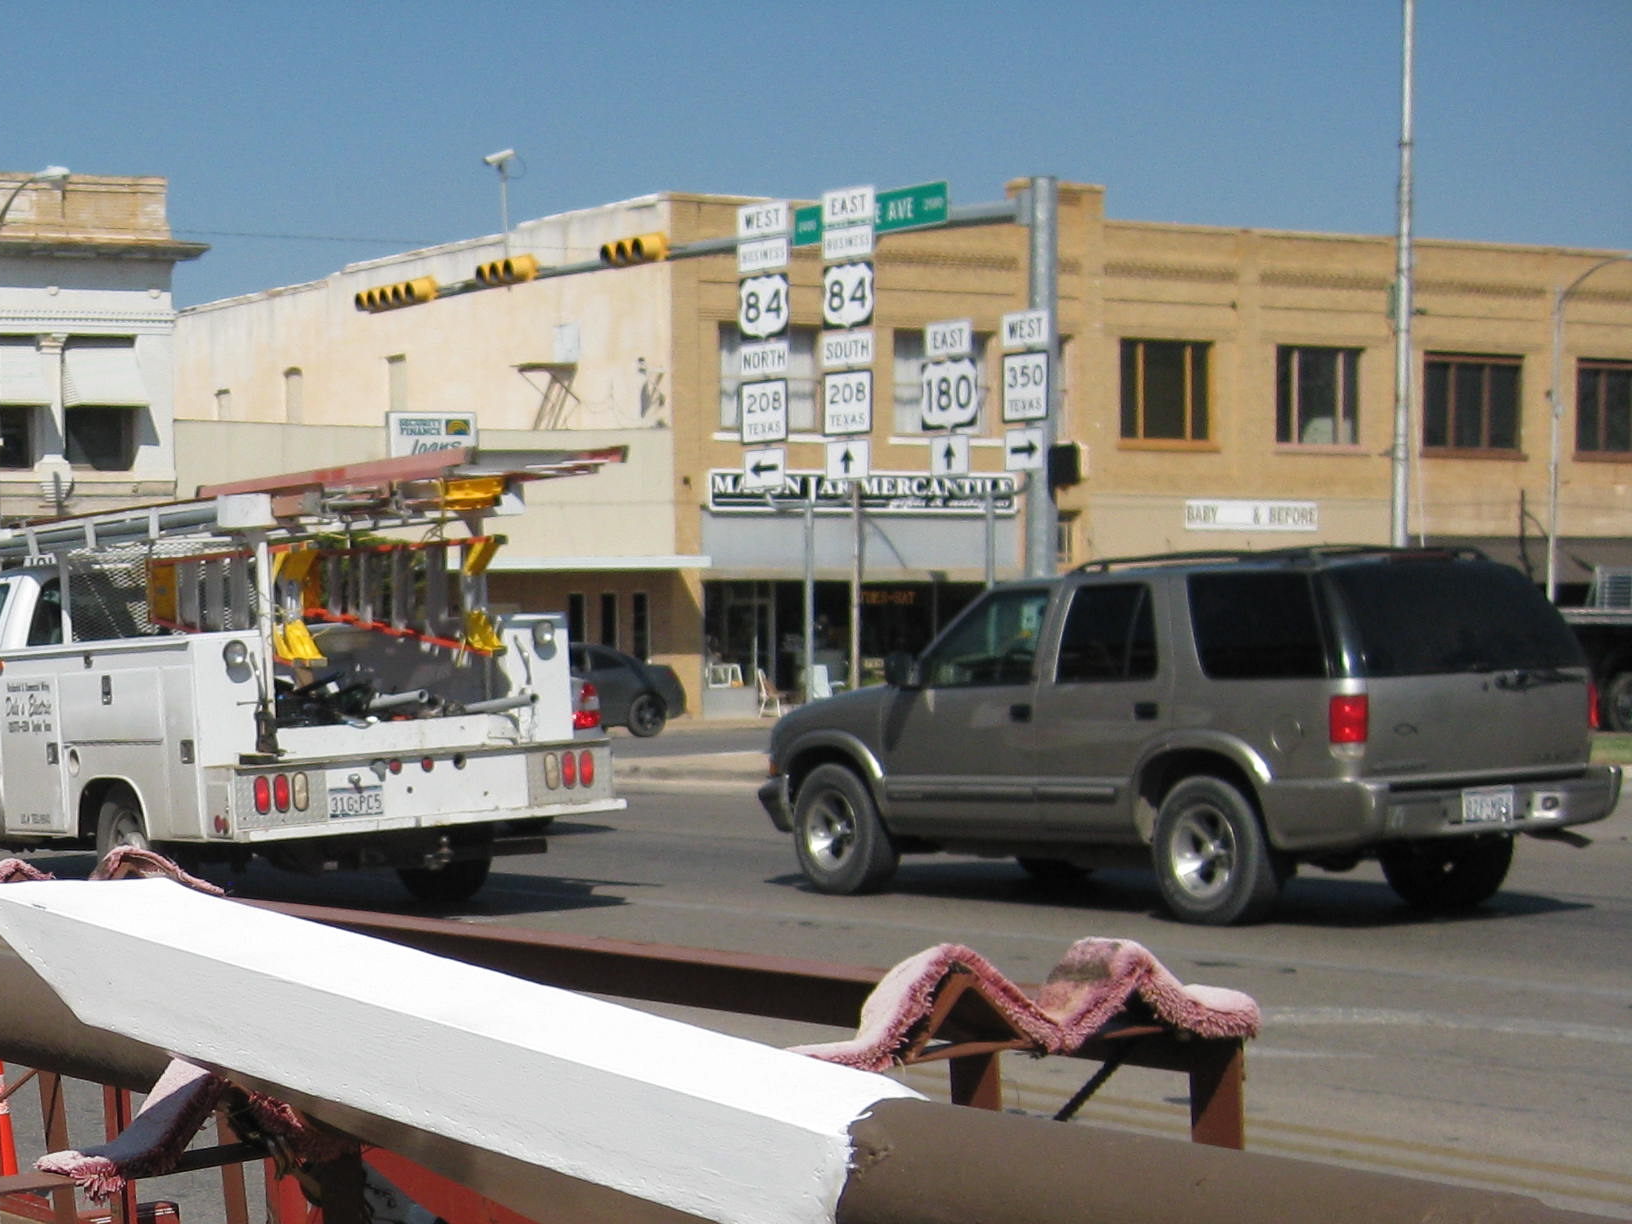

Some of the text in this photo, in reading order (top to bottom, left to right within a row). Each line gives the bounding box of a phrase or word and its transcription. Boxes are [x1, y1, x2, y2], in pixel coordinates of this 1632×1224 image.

[831, 194, 866, 216] EAST
[888, 197, 914, 221] AVE
[744, 208, 780, 231] WEST
[827, 235, 870, 251] BUSINESS
[742, 247, 786, 264] BUSINESS
[829, 276, 867, 312] 84
[745, 288, 782, 323] 84
[933, 328, 965, 350] EAST
[1009, 318, 1043, 340] WEST
[743, 350, 786, 370] NORTH
[826, 340, 869, 360] SOUTH
[1009, 364, 1044, 389] 350
[747, 391, 782, 414] 208
[829, 382, 866, 404] 208
[927, 374, 972, 413] 180
[1009, 398, 1043, 417] TEXAS
[748, 421, 782, 435] TEXAS
[829, 413, 865, 428] TEXAS
[862, 476, 1013, 496] MERCANTILE
[1187, 504, 1218, 523] BABY
[1269, 506, 1317, 526] BEFORE
